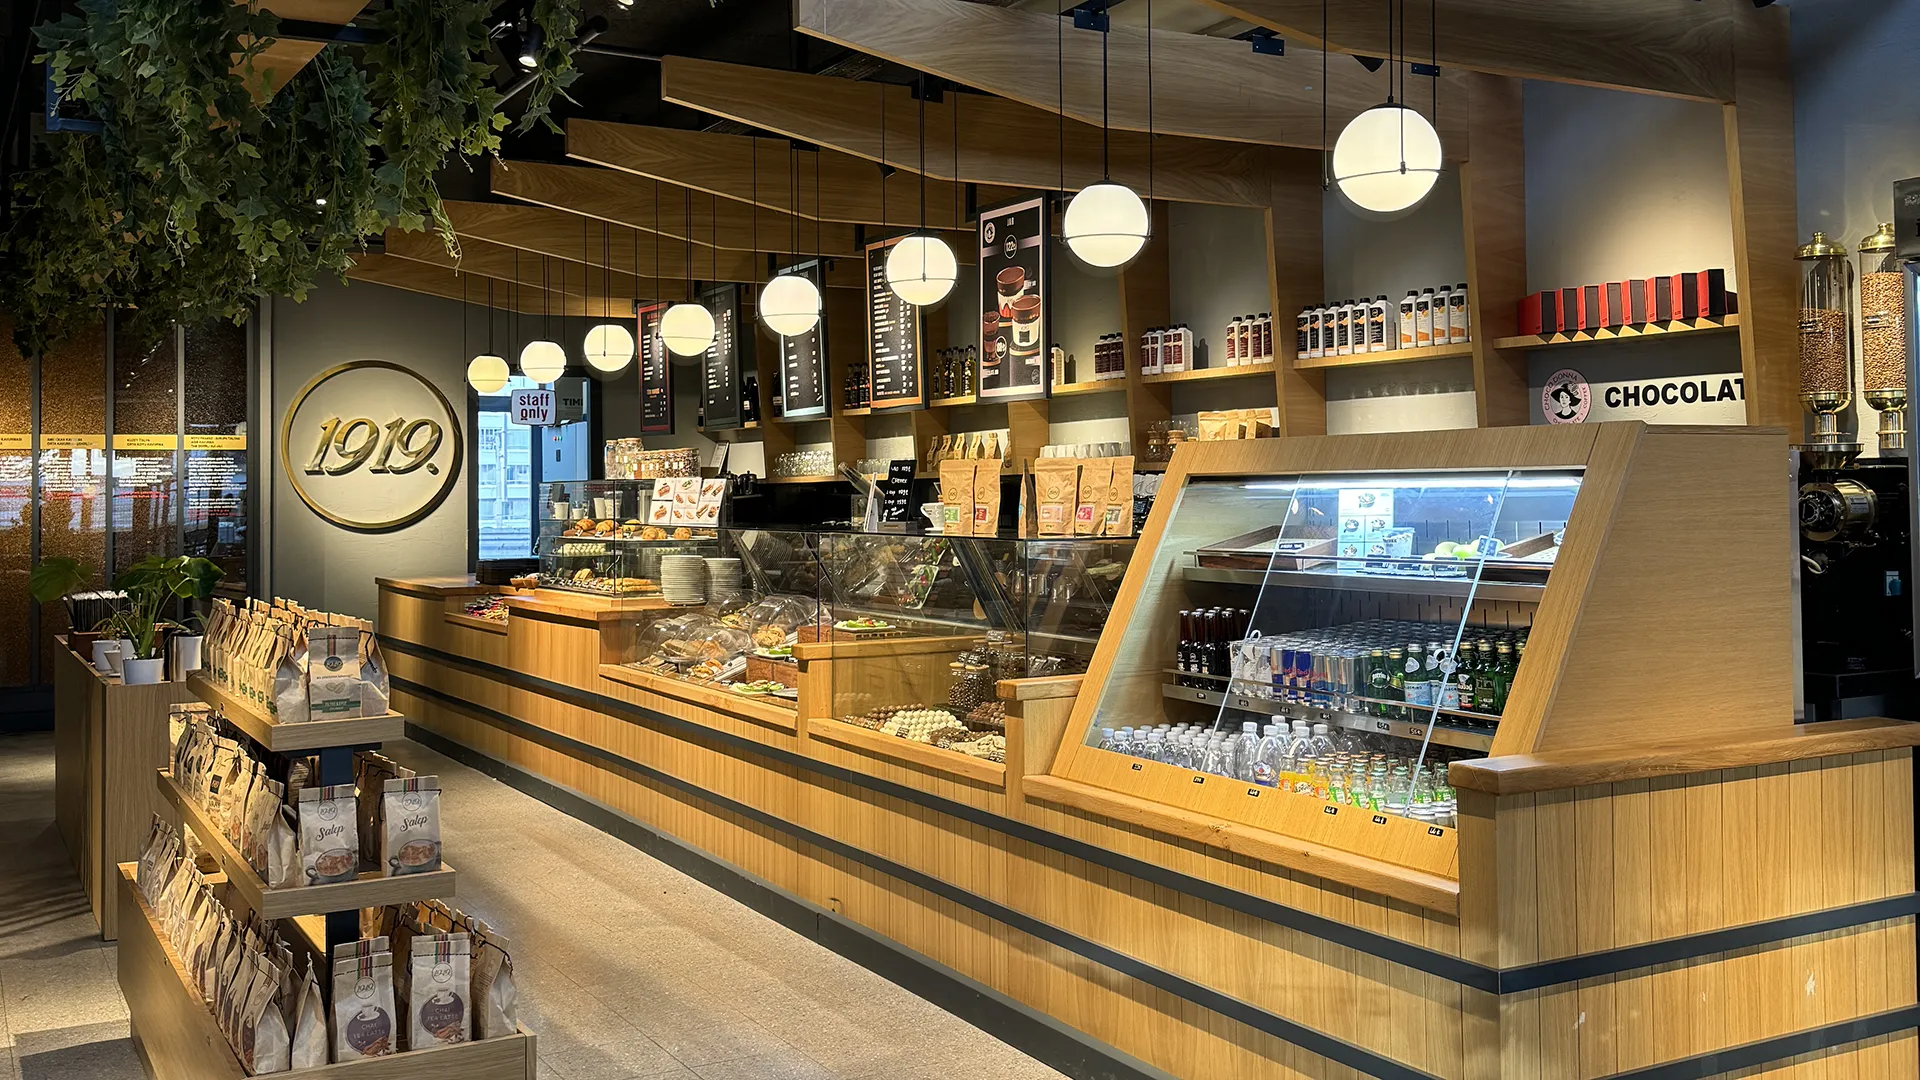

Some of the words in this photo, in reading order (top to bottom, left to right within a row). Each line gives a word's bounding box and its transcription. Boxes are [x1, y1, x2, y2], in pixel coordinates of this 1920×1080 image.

[1552, 372, 1578, 383] DONNA
[519, 393, 550, 406] staff
[520, 406, 548, 422] only
